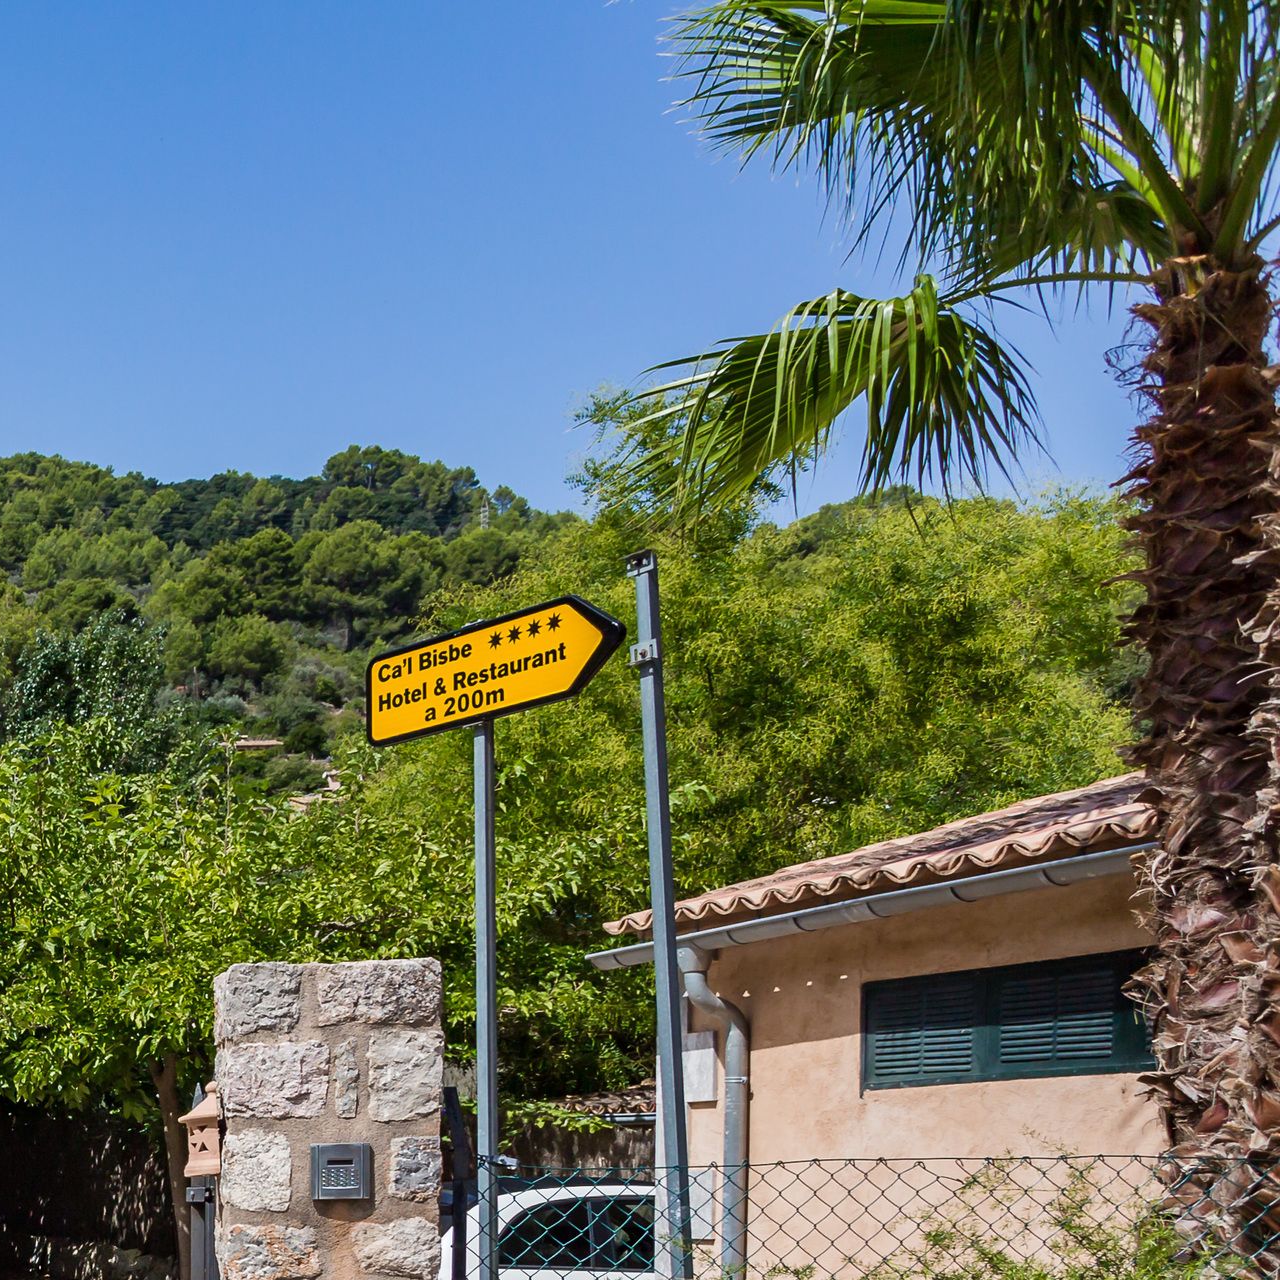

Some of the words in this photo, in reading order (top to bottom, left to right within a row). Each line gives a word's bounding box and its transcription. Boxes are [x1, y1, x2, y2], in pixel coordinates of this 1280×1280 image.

[377, 656, 413, 683] Ca'l
[418, 643, 473, 671] Bisbe
[378, 681, 428, 713] Hotel
[433, 677, 447, 697] &
[453, 642, 567, 691] Restaurant
[424, 706, 437, 722] a
[443, 688, 505, 717] 200m
